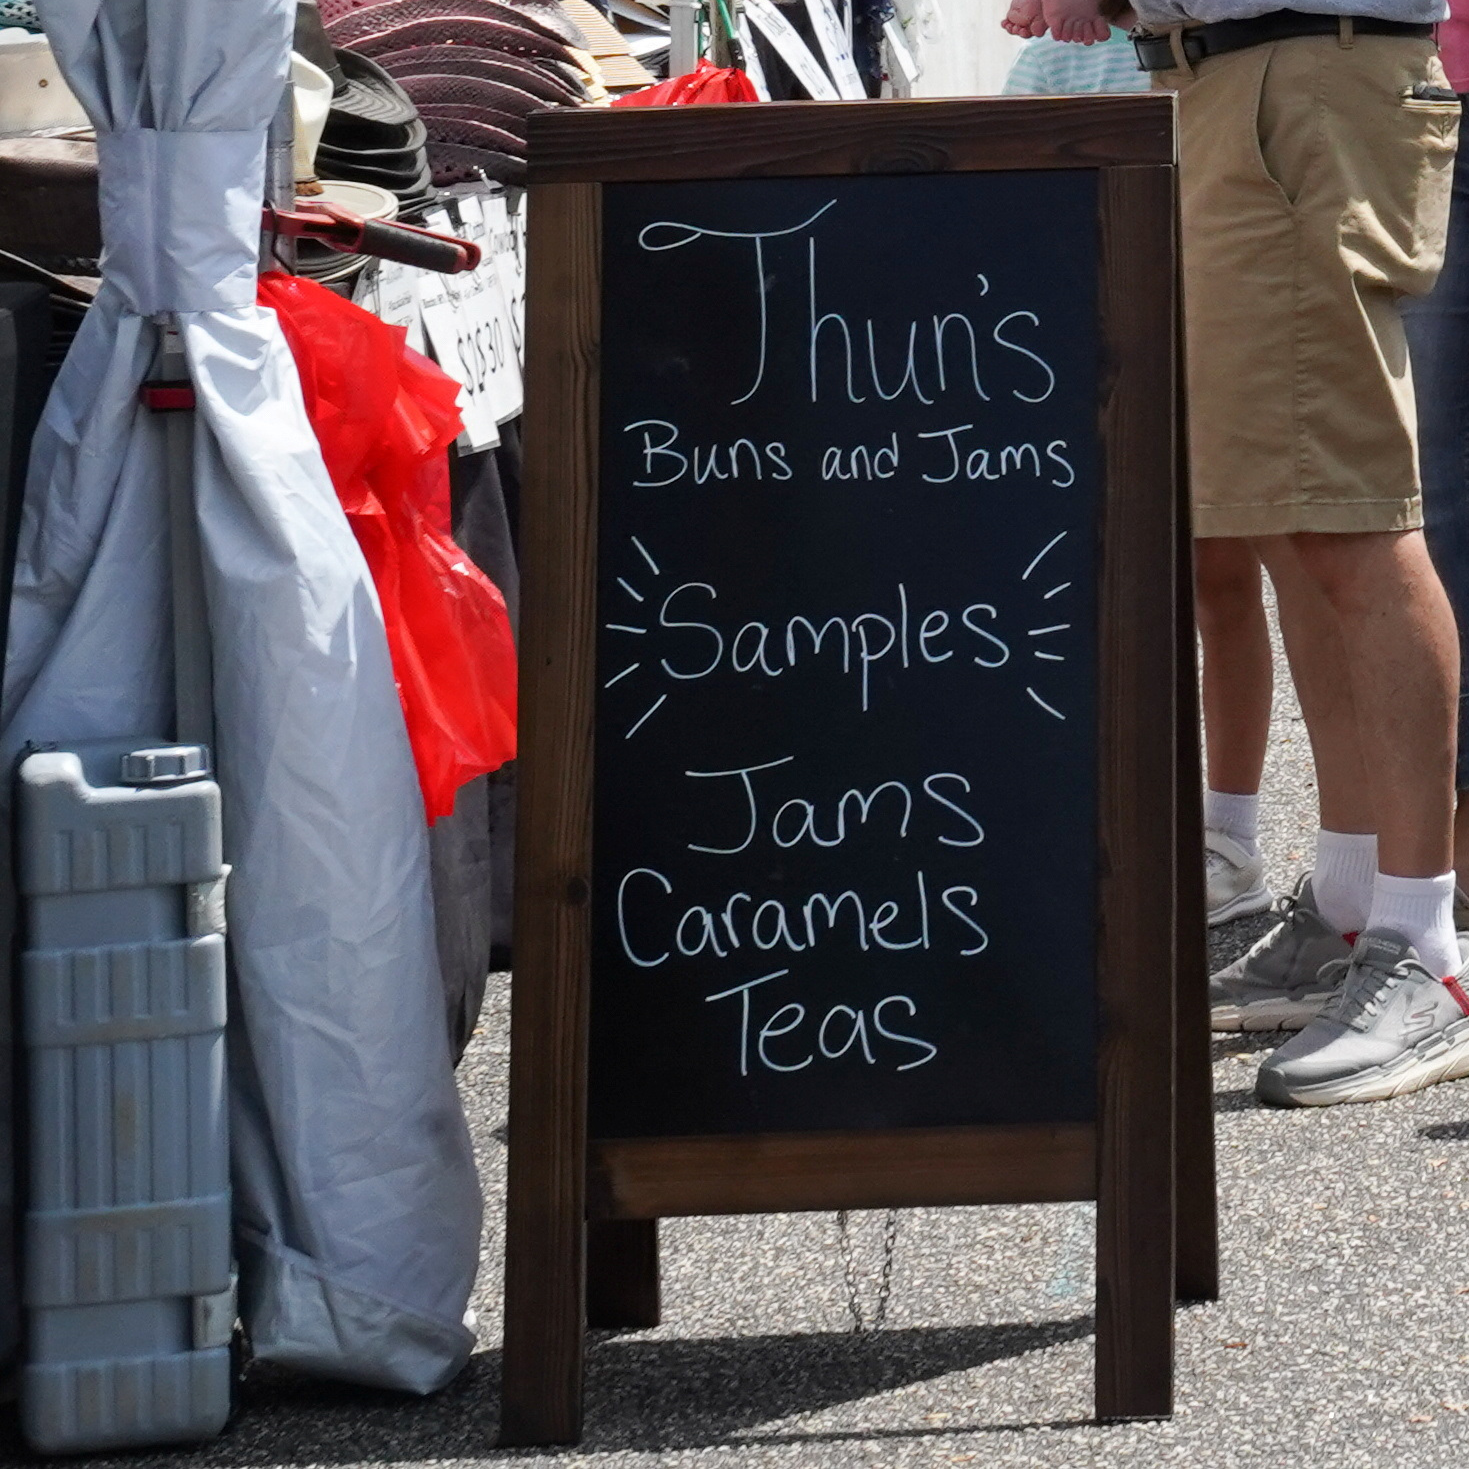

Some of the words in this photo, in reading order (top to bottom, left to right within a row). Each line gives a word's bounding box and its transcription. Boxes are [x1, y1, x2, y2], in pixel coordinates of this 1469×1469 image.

[639, 199, 1054, 404] Thun's
[624, 420, 792, 486] Buns
[821, 430, 899, 480] and
[918, 425, 1074, 487] Jams
[660, 582, 1011, 711] Samples
[685, 756, 984, 853] Jams
[618, 868, 988, 966] Caramels
[705, 969, 937, 1076] Teas
